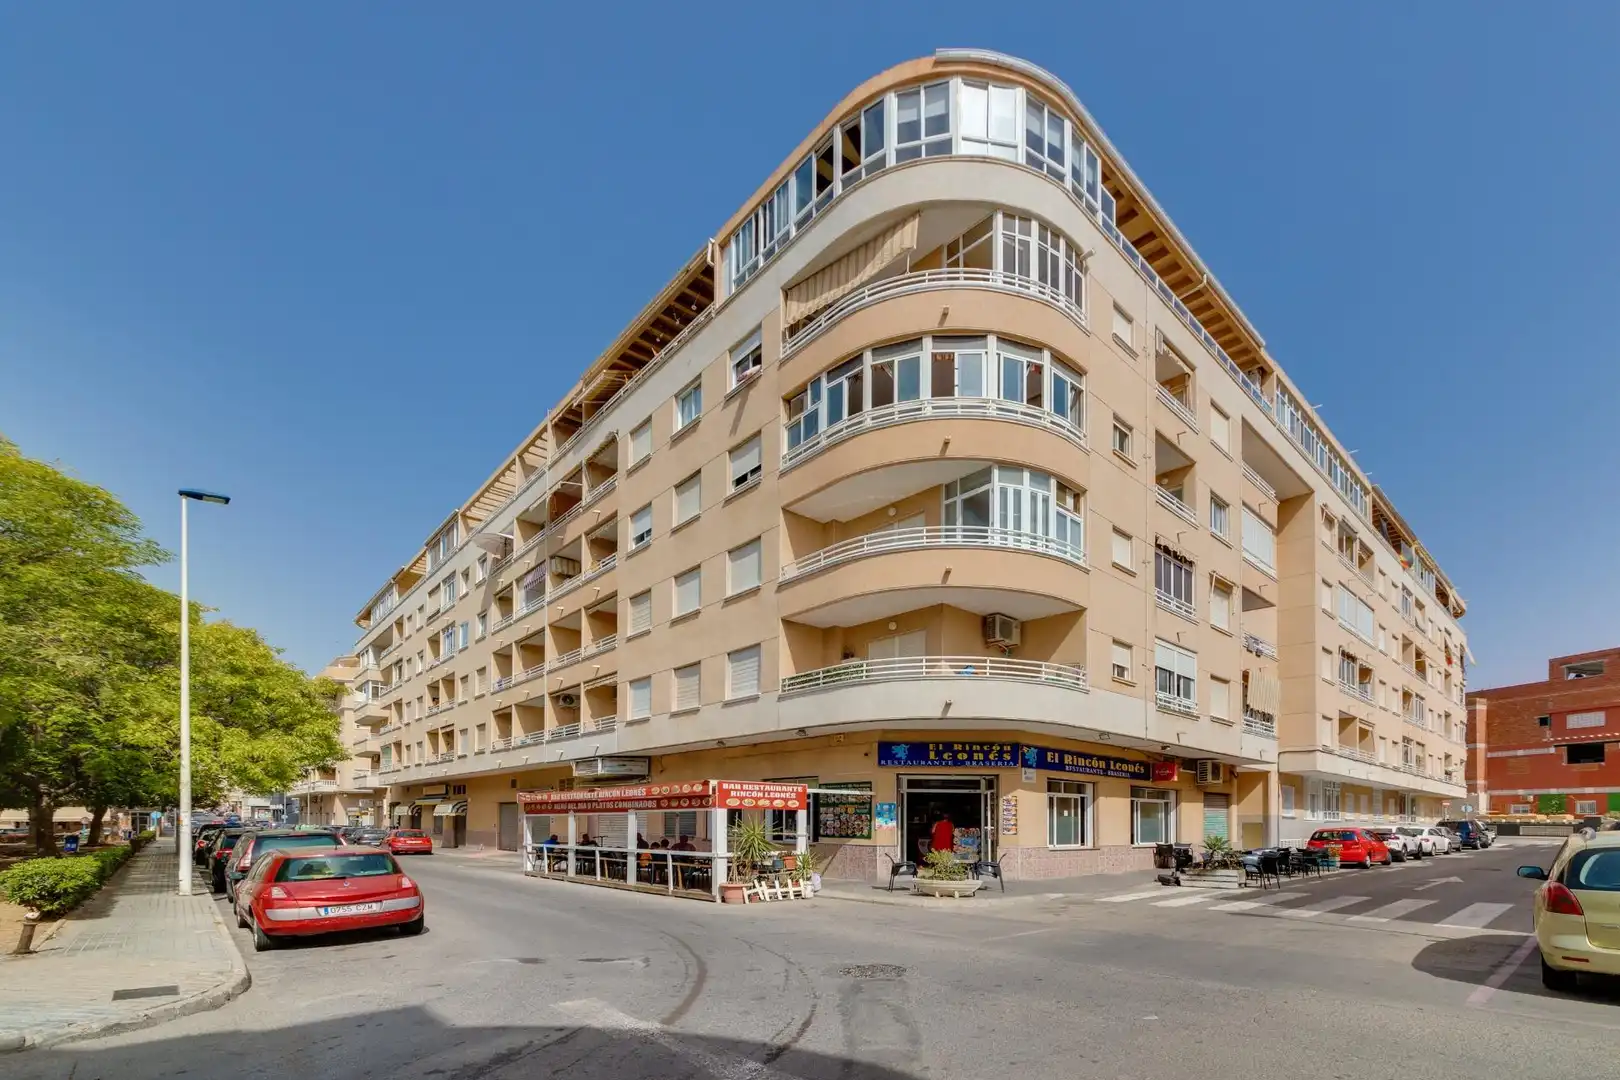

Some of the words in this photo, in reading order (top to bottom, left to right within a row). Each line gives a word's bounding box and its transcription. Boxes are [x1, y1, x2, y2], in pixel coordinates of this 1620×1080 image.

[929, 743, 942, 751] El
[953, 743, 1011, 751] Rincón
[1047, 751, 1059, 763] El
[1064, 754, 1106, 769] Rincón
[1065, 765, 1103, 775] RESTAURANTE
[743, 784, 803, 792] RESTAURANTE
[730, 790, 763, 798] RINCÓN
[614, 799, 657, 809] COMBINADOS
[330, 906, 353, 914] 0755
